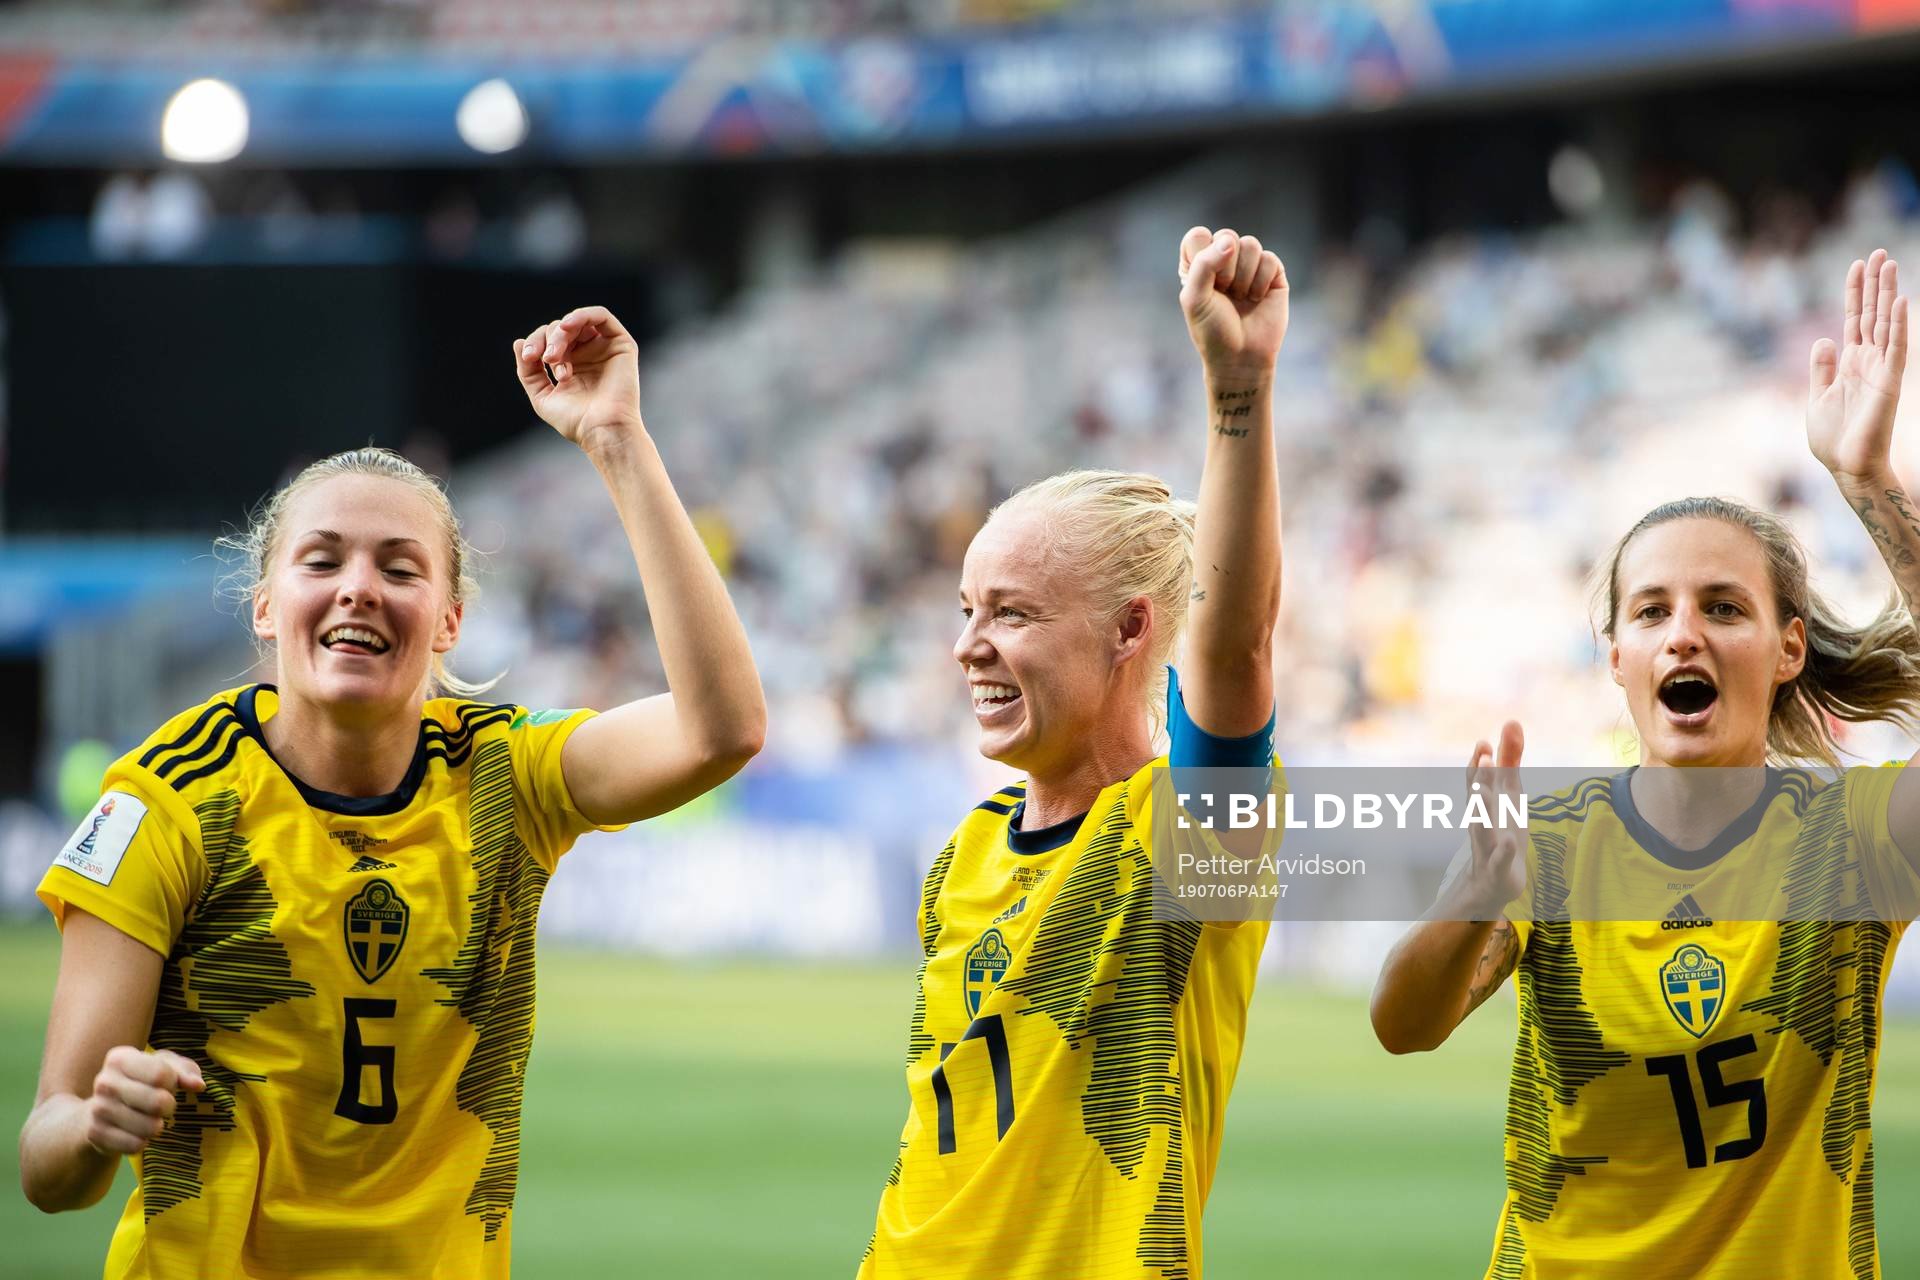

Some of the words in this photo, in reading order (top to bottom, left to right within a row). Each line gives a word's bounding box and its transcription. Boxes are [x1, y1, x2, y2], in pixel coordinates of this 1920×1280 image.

[356, 911, 398, 919] SVERIGE
[1661, 916, 1713, 931] adidas
[974, 960, 1003, 968] SVERIGE
[1672, 970, 1713, 981] SVERIGE
[334, 997, 398, 1125] 6
[1645, 1032, 1768, 1170] 15
